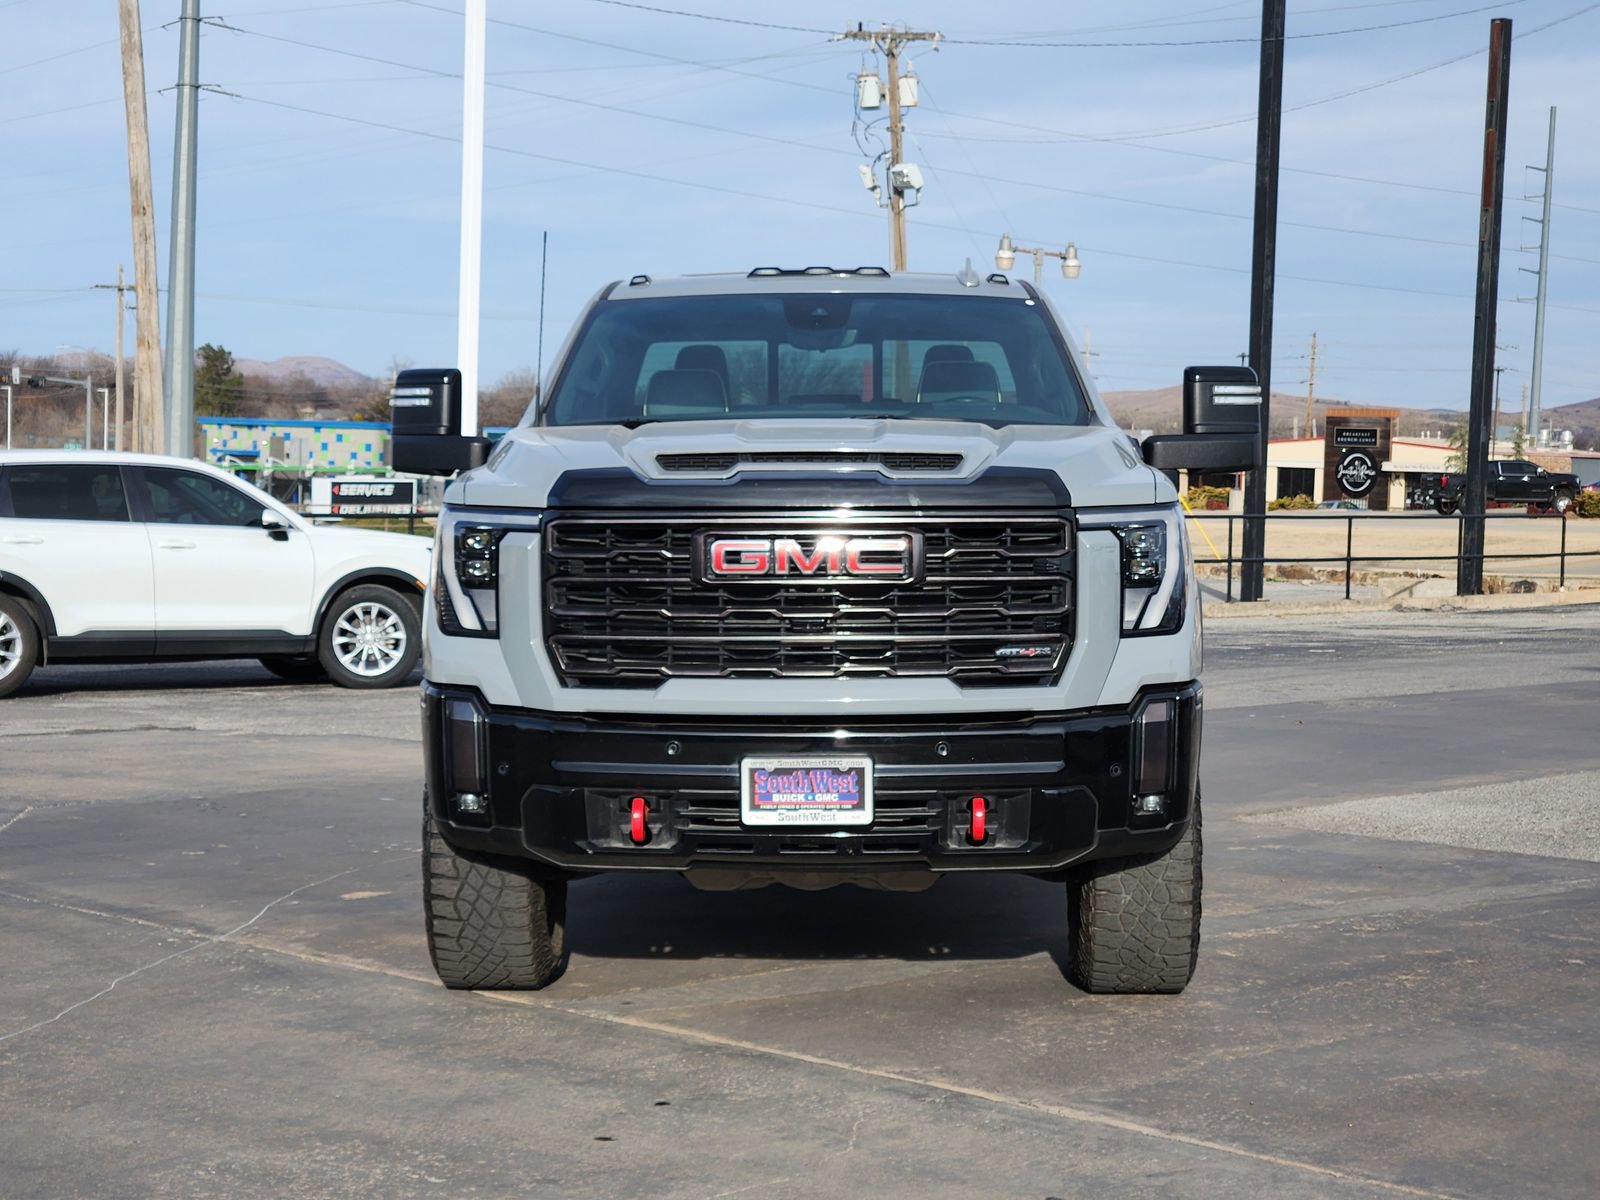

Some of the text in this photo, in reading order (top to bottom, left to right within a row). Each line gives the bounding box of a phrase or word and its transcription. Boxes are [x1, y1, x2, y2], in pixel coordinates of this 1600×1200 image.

[339, 484, 395, 497] SERVICE
[710, 538, 907, 574] GMC
[754, 769, 859, 793] SouthWest
[772, 793, 839, 802] BUICK GMC
[777, 812, 836, 822] SouthWest
